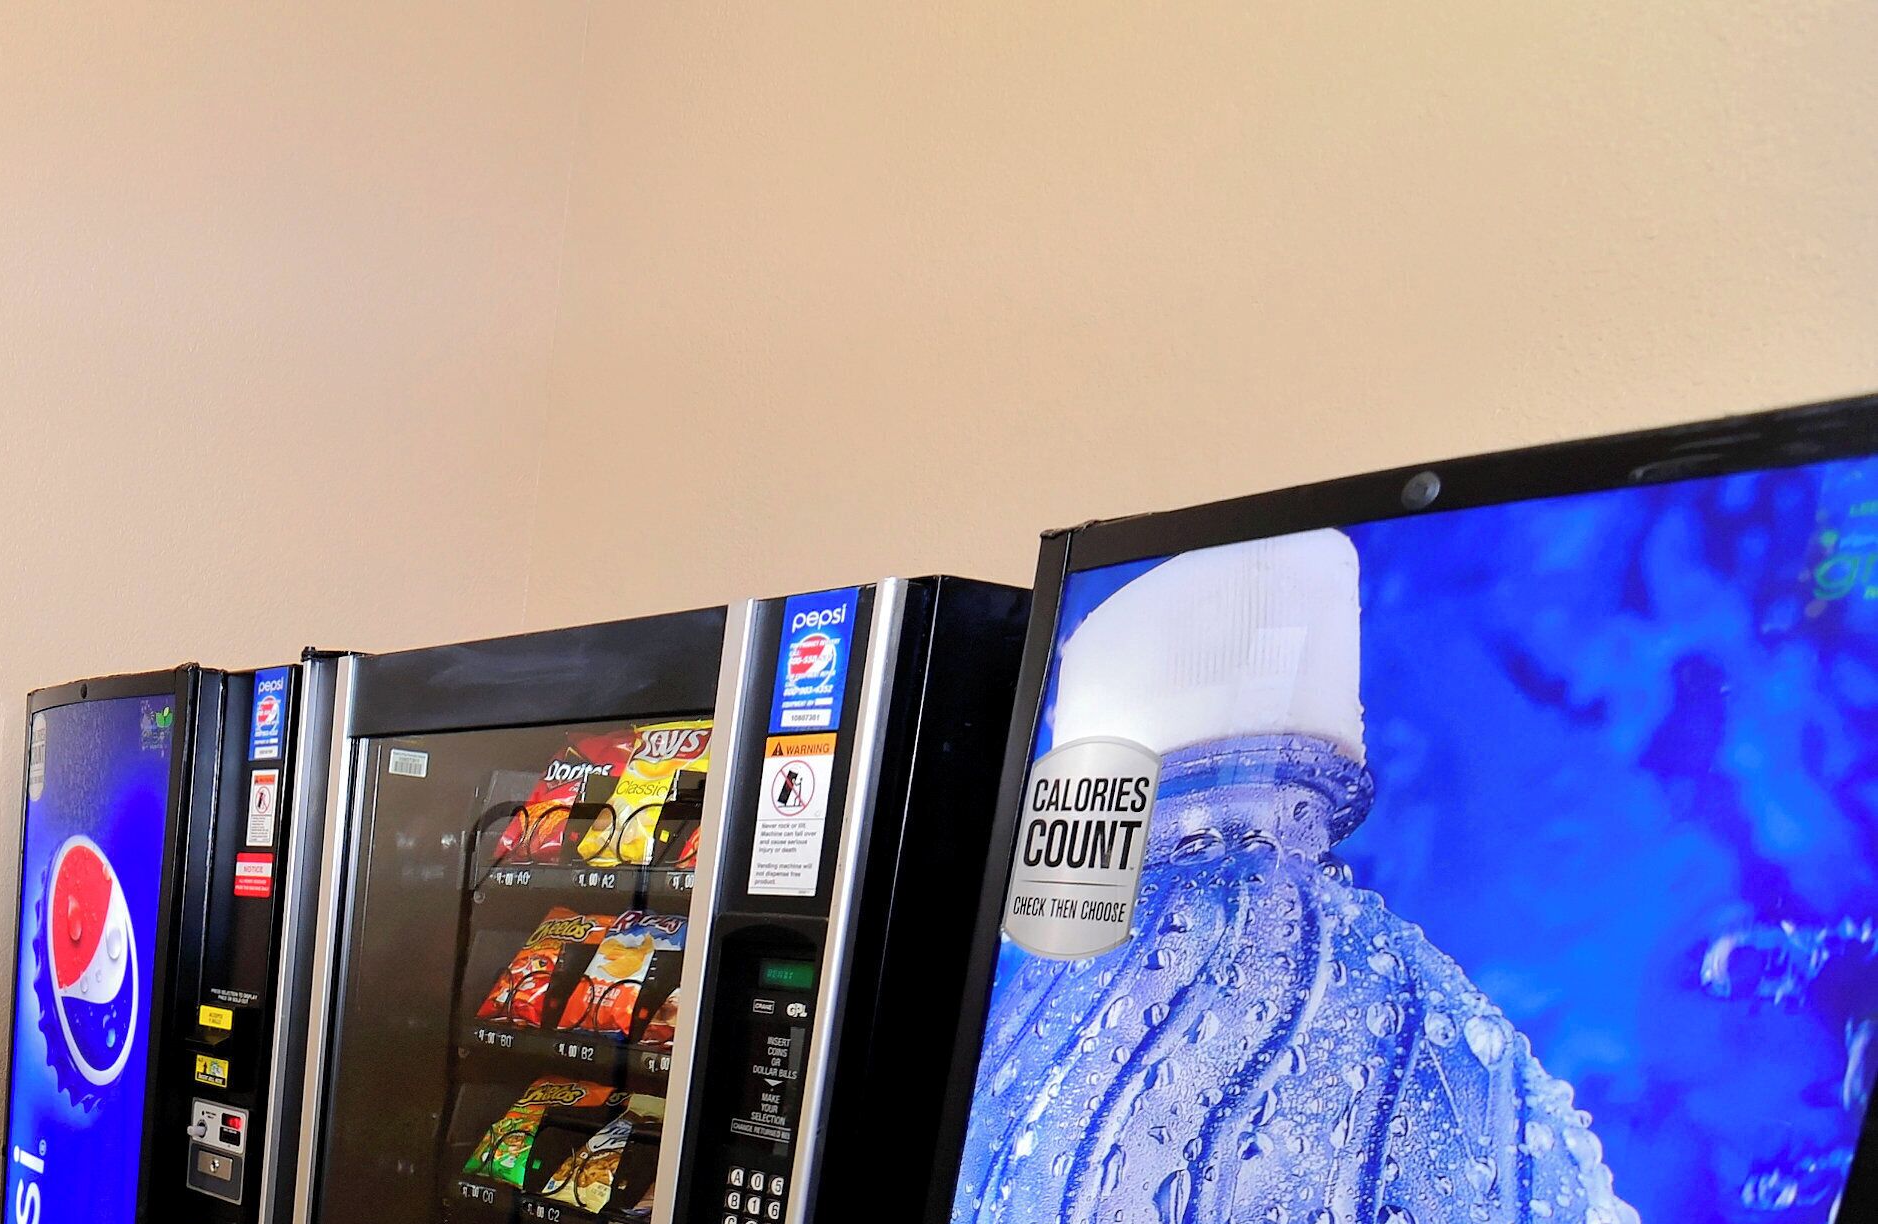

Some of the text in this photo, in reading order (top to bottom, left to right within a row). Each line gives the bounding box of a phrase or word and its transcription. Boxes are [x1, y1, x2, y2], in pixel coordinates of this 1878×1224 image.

[791, 603, 847, 634] pepsi
[258, 676, 284, 695] pepsi
[786, 743, 831, 756] WARNING
[616, 780, 668, 797] Classic
[1032, 776, 1151, 813] CALORIES
[1023, 818, 1142, 871] COUNT
[242, 866, 264, 874] NOTICE
[602, 874, 615, 889] A2
[1013, 896, 1128, 923] CHECK THEN CHOOSE
[767, 1036, 791, 1048] INSERT
[581, 1046, 594, 1061] B2
[767, 1047, 788, 1058] COINS
[771, 1057, 781, 1067] OR
[752, 1065, 797, 1080] DOLLAR BILLS
[761, 1092, 781, 1104] MAKE
[761, 1103, 778, 1114] YOUR
[751, 1111, 786, 1126] SELECTION
[548, 1207, 560, 1223] C2
